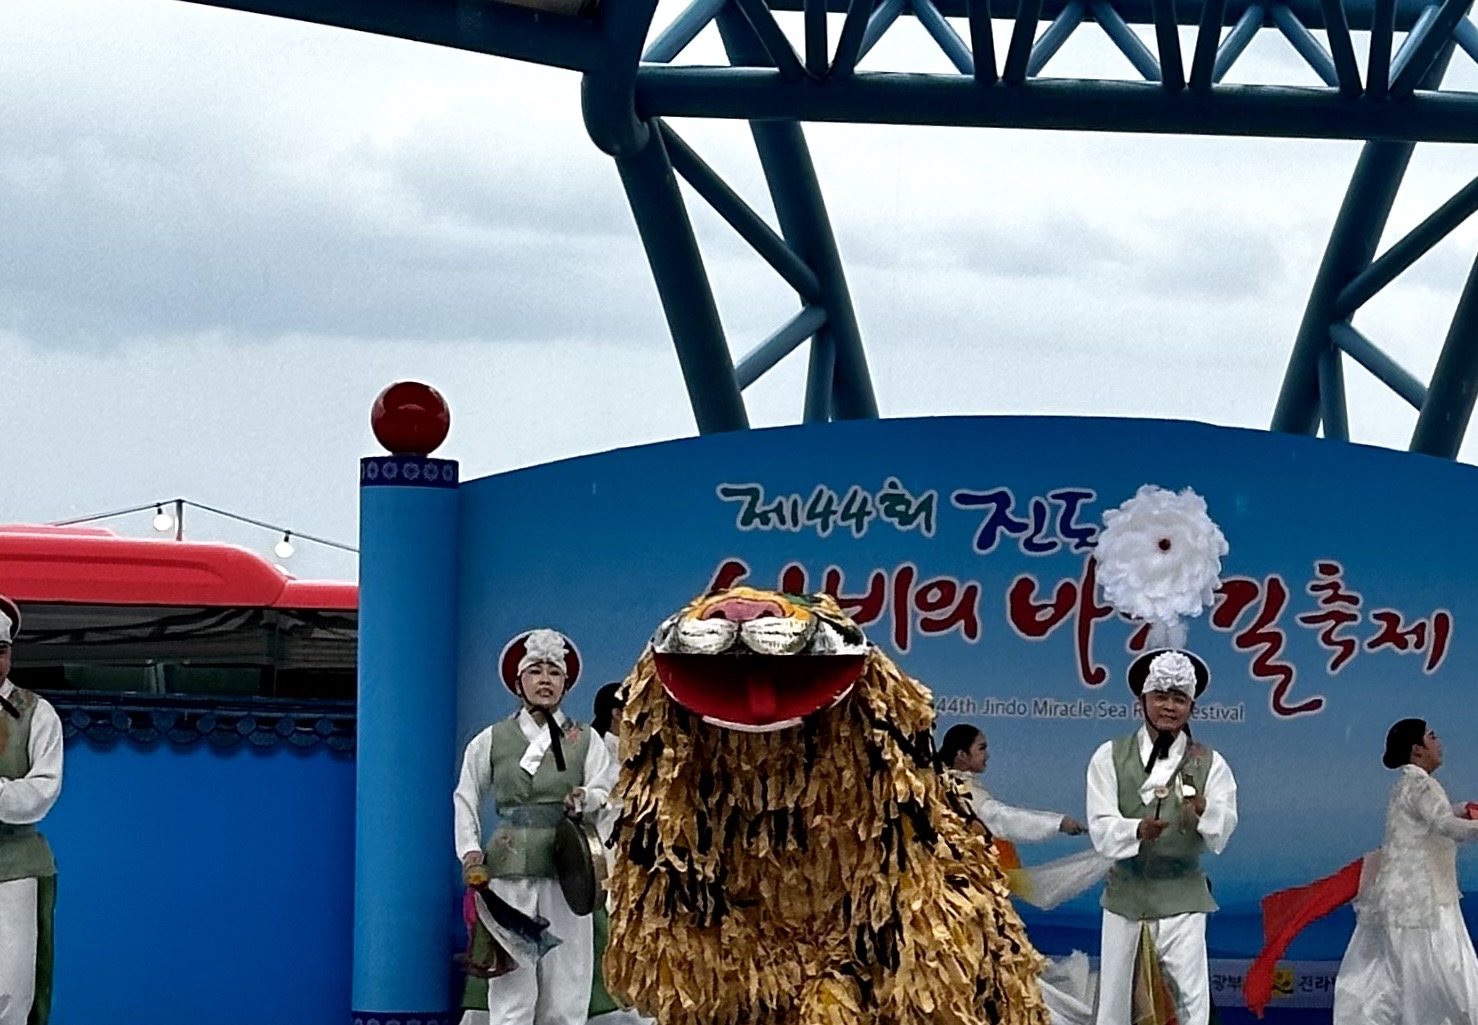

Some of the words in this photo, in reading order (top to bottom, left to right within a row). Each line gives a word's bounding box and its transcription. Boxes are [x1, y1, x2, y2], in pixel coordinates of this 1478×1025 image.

[717, 478, 938, 537] 제44회
[951, 486, 1100, 553] 진도
[702, 558, 980, 653] 비의
[1007, 553, 1325, 718] 바길
[1298, 561, 1452, 674] 축제
[936, 698, 976, 715] 44th
[981, 699, 1028, 716] Jindo
[1033, 700, 1093, 718] Miracle
[1098, 701, 1127, 718] Sea
[1191, 703, 1245, 721] estival
